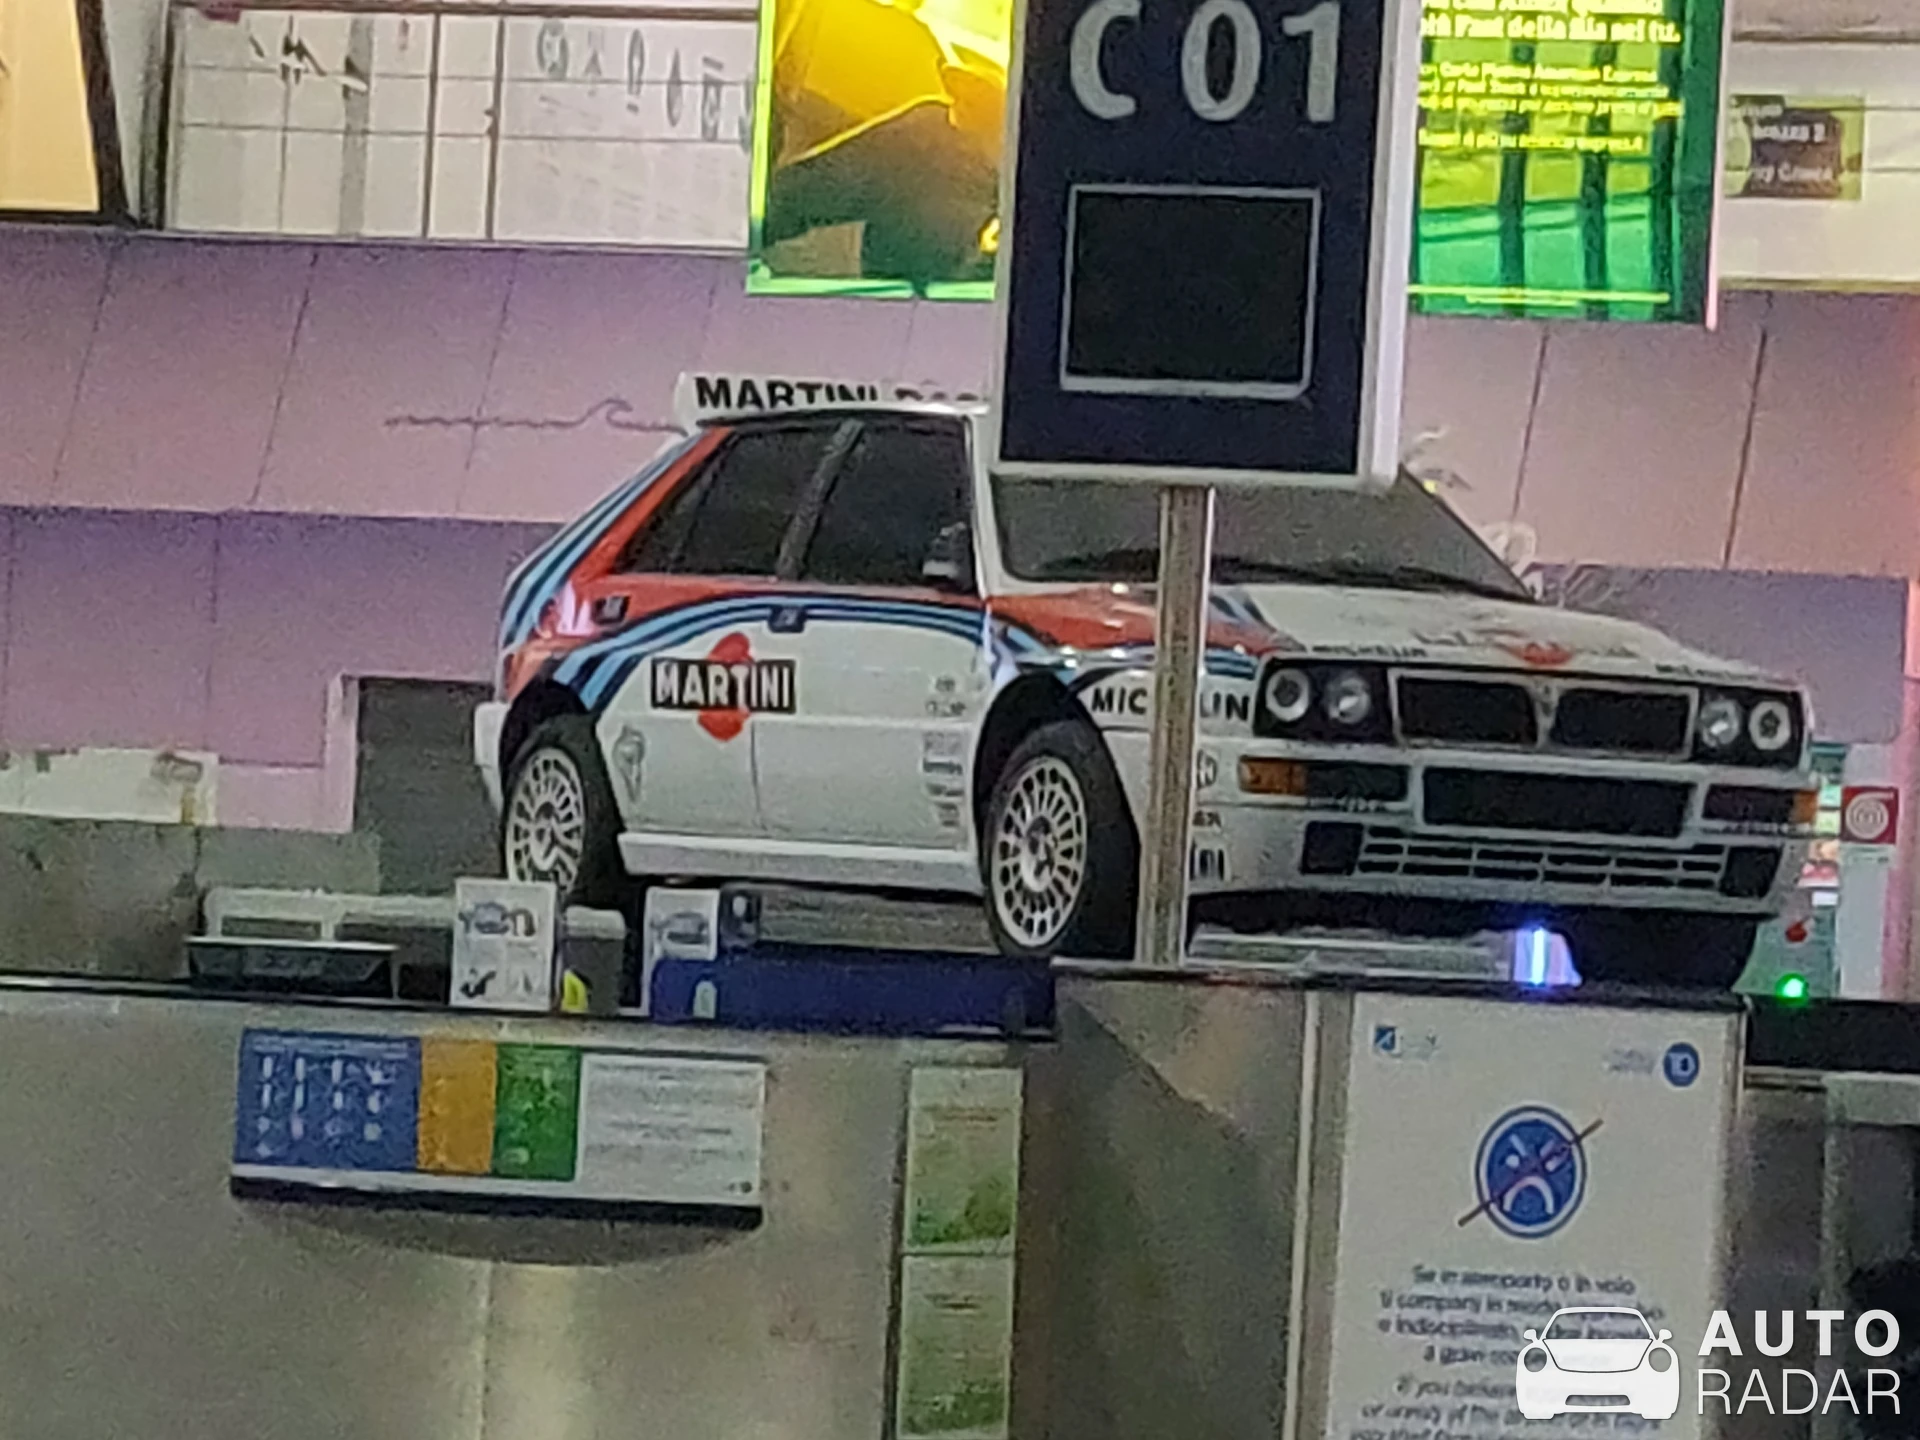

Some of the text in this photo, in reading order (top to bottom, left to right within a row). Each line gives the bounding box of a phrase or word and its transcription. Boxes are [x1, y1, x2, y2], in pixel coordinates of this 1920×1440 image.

[1181, 0, 1340, 122] 01
[694, 376, 878, 410] MARTINI
[655, 665, 790, 708] MARTINI
[1092, 687, 1250, 721] MICLIN
